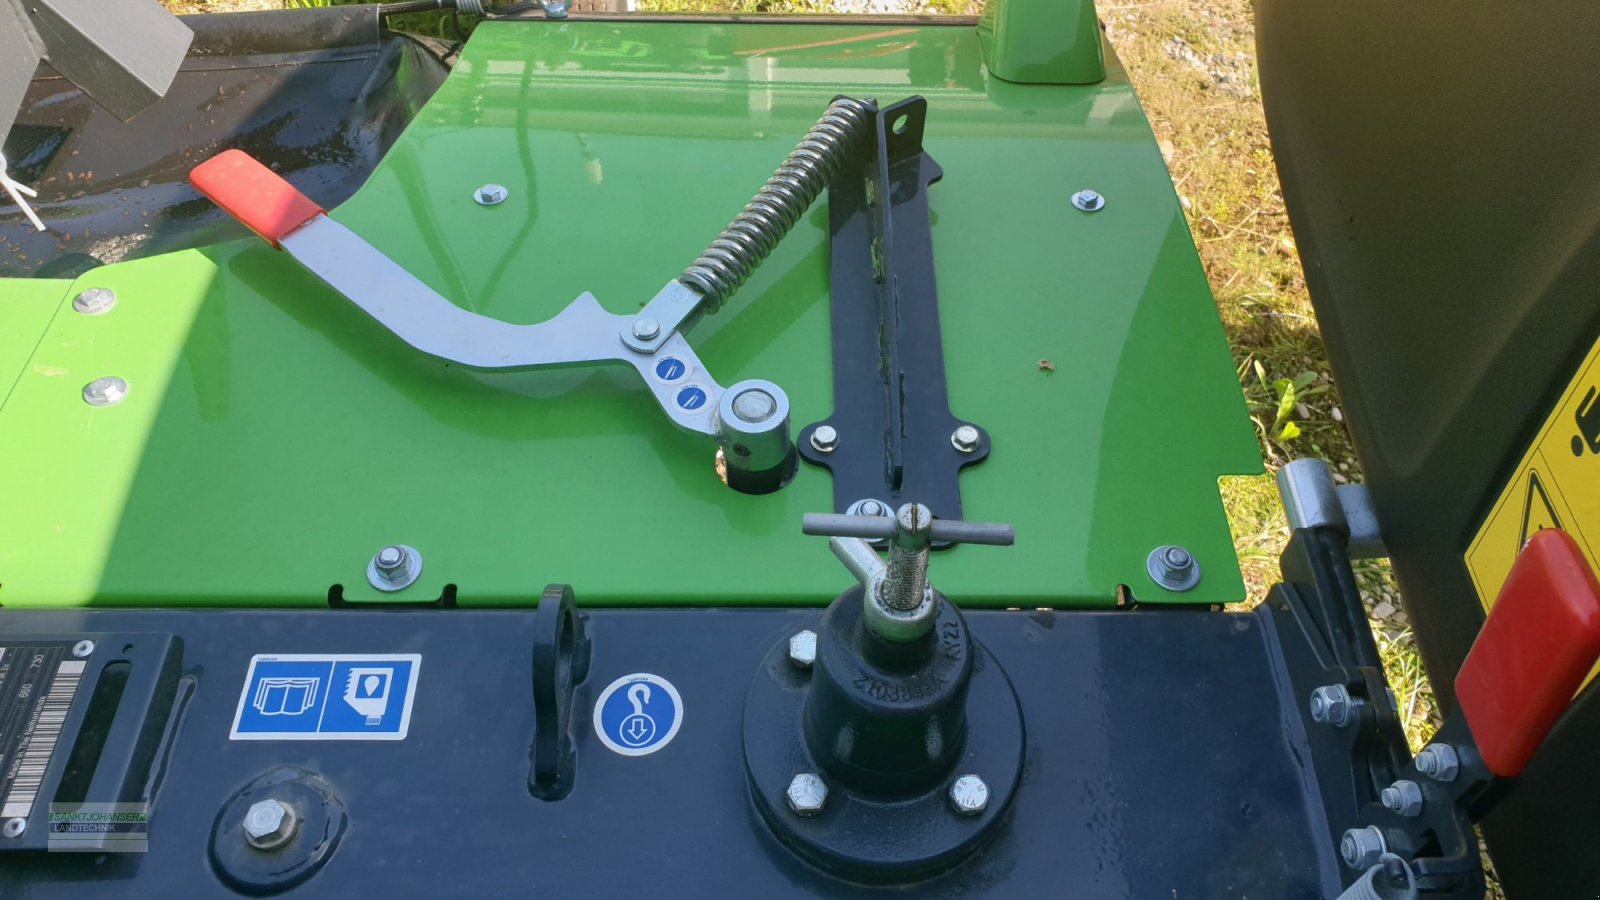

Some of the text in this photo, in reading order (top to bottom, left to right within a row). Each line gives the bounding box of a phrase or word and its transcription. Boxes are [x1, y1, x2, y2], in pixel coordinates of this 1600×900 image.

[7, 759, 21, 779] Made
[18, 736, 30, 749] The
[24, 696, 47, 736] Netherlands
